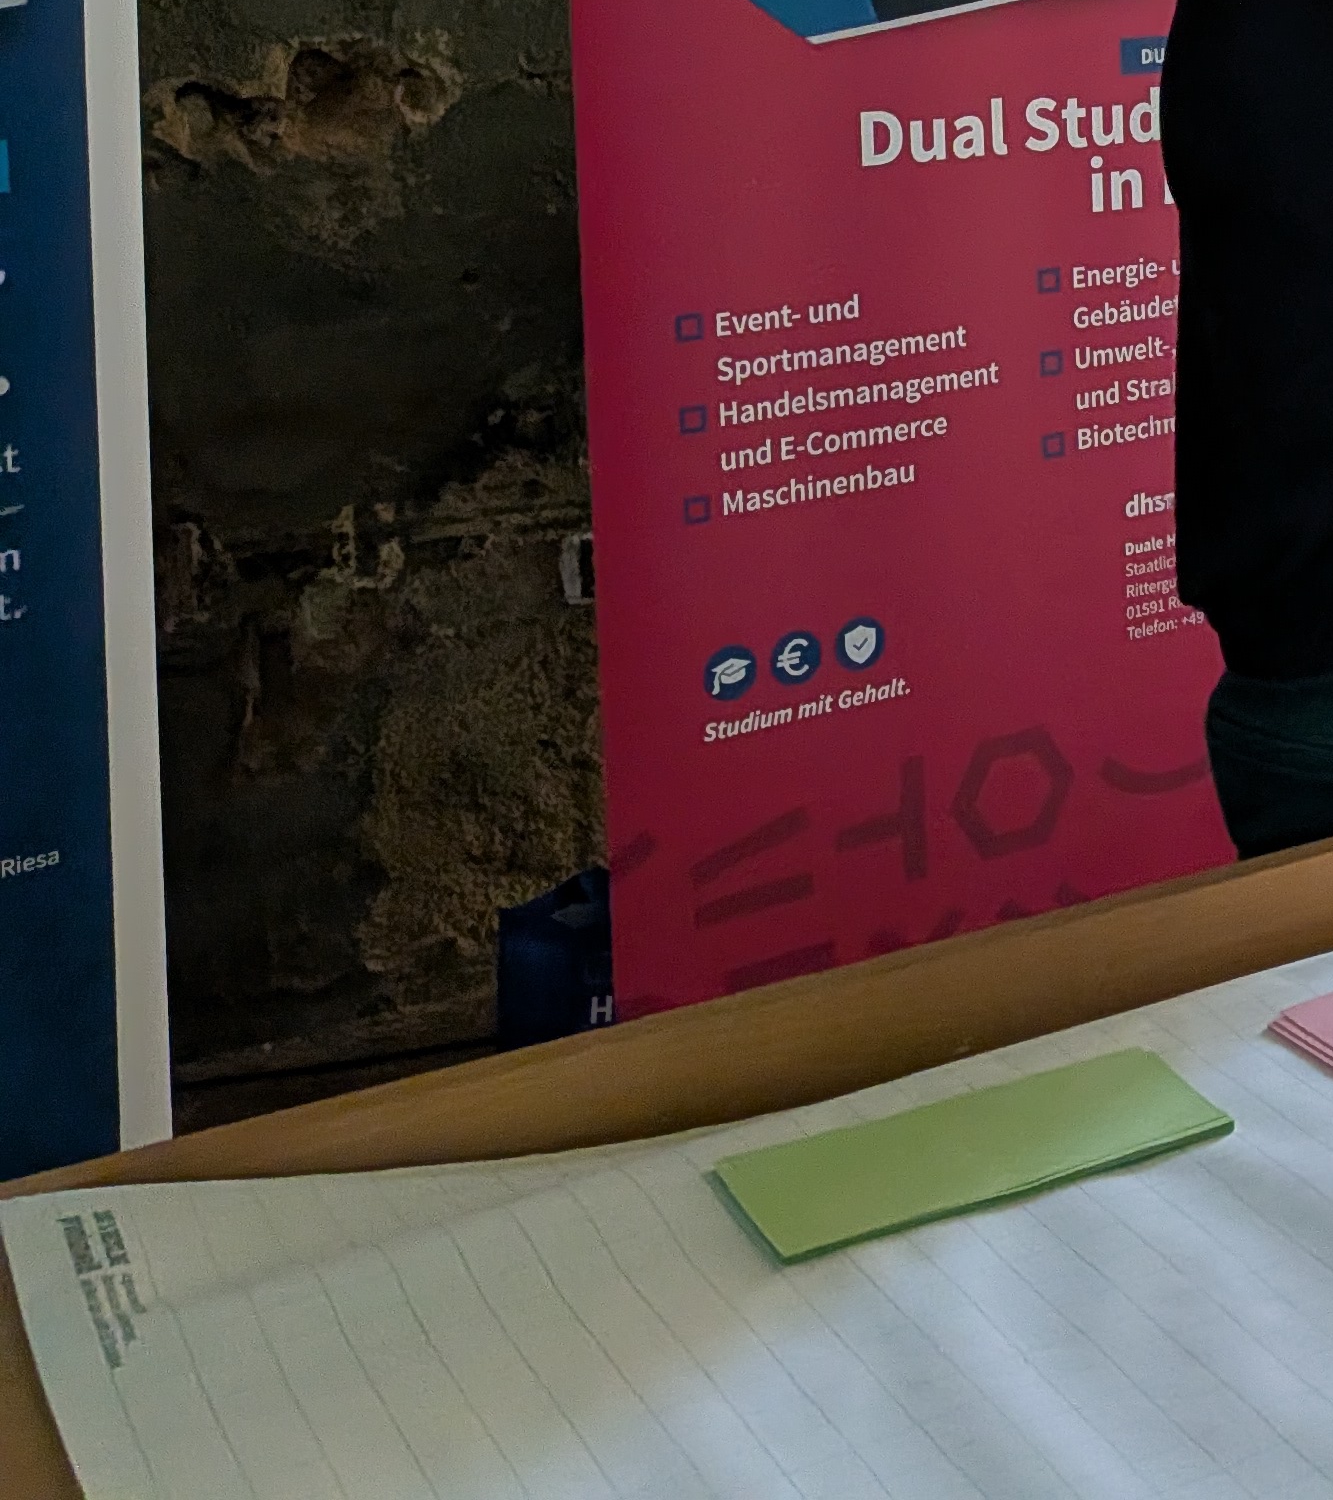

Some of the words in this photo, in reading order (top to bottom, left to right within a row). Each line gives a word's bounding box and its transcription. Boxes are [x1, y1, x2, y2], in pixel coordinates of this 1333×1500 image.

[859, 97, 1008, 167] Dual
[1025, 86, 1162, 151] Stud
[1090, 155, 1143, 213] in
[1072, 258, 1166, 289] Energie-
[715, 306, 801, 337] Event-
[809, 293, 860, 324] und
[1073, 295, 1179, 329] Gebäudet
[716, 325, 967, 386] Sportmanagement
[718, 362, 1000, 427] Handelsmanagement
[1076, 381, 1120, 410] und
[1126, 372, 1176, 401] Stra
[720, 439, 772, 471] und
[780, 415, 948, 462] E-Commerce
[1077, 414, 1175, 450] Biotechn
[722, 464, 916, 516] Maschinenbau
[1125, 492, 1175, 518] dhsn
[1125, 536, 1163, 556] Duale
[1125, 555, 1176, 577] Staatlic
[1126, 578, 1177, 598] Rittergu
[1126, 599, 1165, 620] 01591
[1127, 618, 1177, 641] Telefon:
[703, 704, 793, 743] Studium
[797, 694, 834, 720] mit
[837, 677, 912, 709] Gehalt.
[1, 850, 60, 878] Riesa
